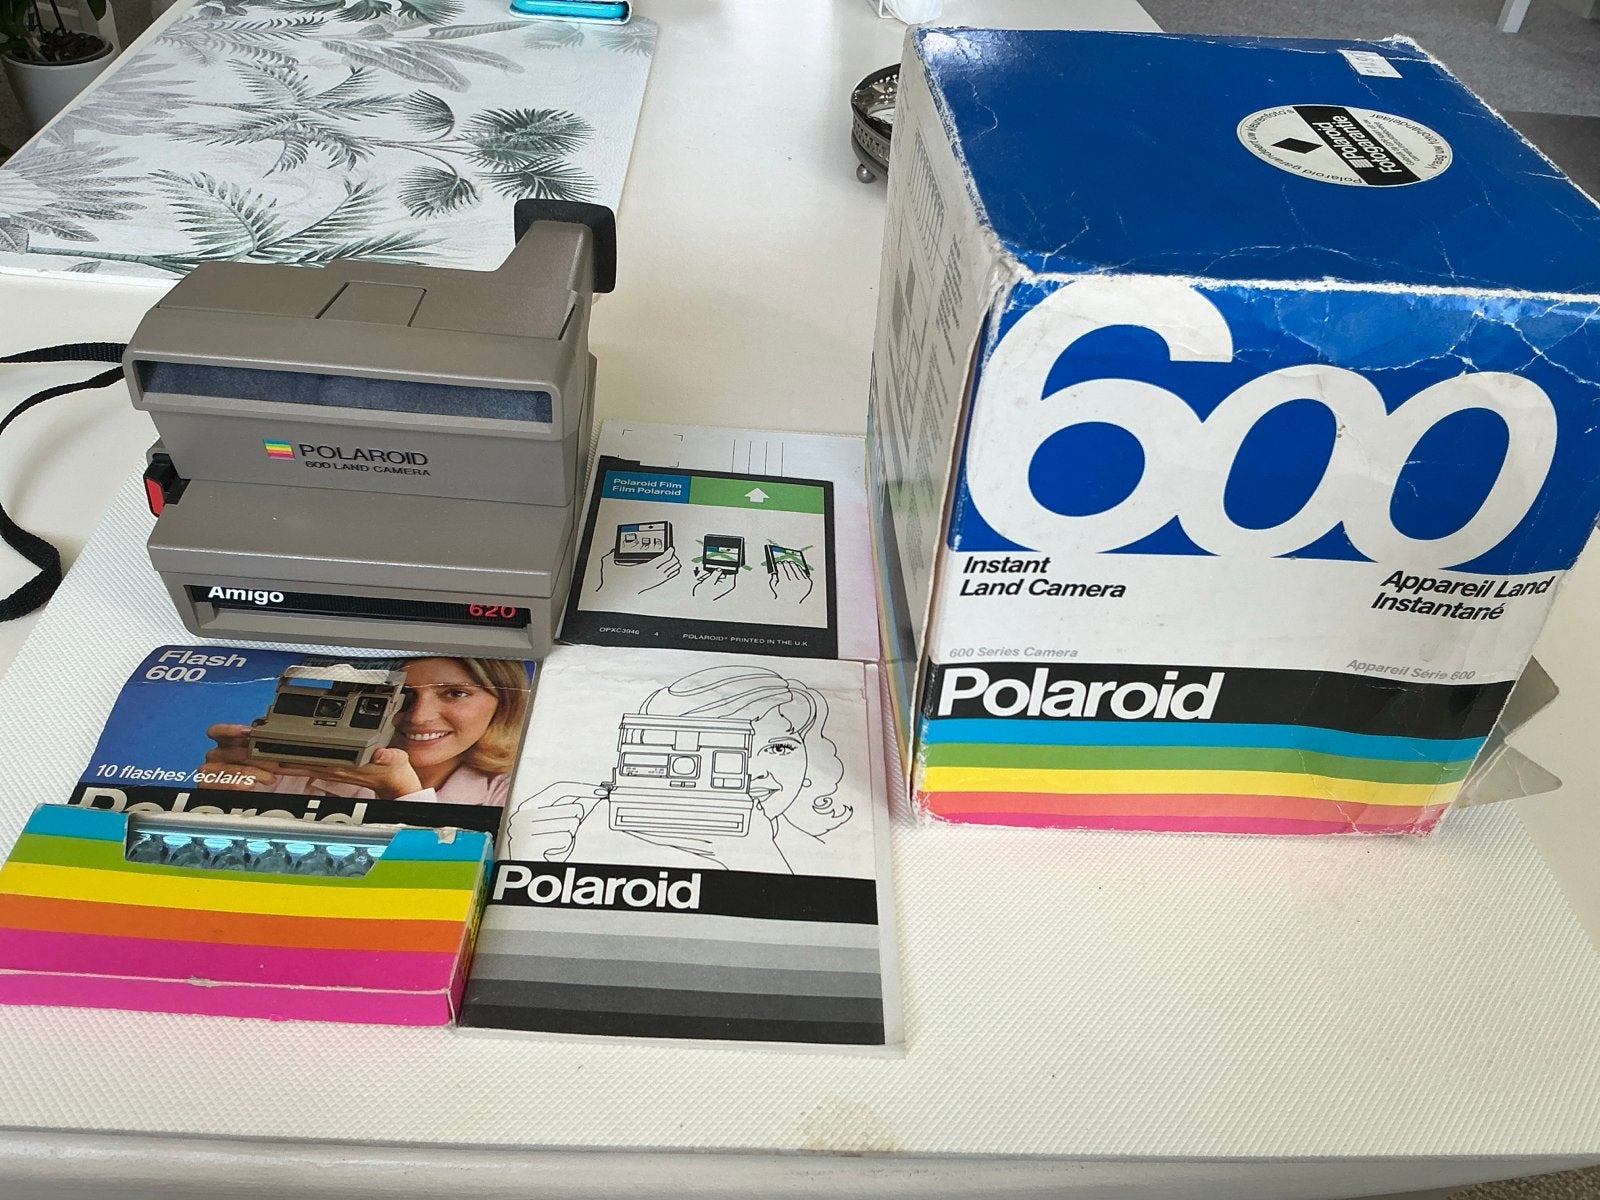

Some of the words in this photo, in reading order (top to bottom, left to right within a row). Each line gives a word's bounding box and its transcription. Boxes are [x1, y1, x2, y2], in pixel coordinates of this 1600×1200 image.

[1311, 122, 1365, 158] Polaroid
[1331, 115, 1402, 172] Fotogarantie
[1302, 169, 1362, 184] Polaroid
[967, 275, 1558, 569] 600
[299, 444, 429, 466] POLAROID
[306, 460, 331, 470] 600
[333, 462, 369, 473] LAND
[374, 465, 431, 476] CAMERA
[612, 486, 635, 494] Film
[637, 487, 682, 495] Polaroid
[613, 478, 658, 487] Polaroid
[660, 480, 682, 489] Film
[963, 556, 1051, 574] Instant
[959, 580, 1023, 597] Land
[1028, 579, 1126, 598] Camera
[1380, 570, 1496, 598] Appareil
[1494, 576, 1556, 598] Land
[208, 586, 284, 604] Amigo
[468, 602, 516, 619] 620
[1371, 592, 1506, 620] Instantané
[730, 636, 765, 644] PRINTED
[157, 650, 247, 668] Flash
[950, 648, 975, 658] 600
[977, 647, 1020, 658] Series
[1024, 646, 1078, 658] Camera
[145, 666, 206, 682] 600
[1346, 659, 1410, 676] Appareil
[1450, 670, 1476, 680] 600
[938, 668, 1225, 720] Polaroid
[96, 764, 118, 778] 10
[492, 863, 701, 910] Polaroid
